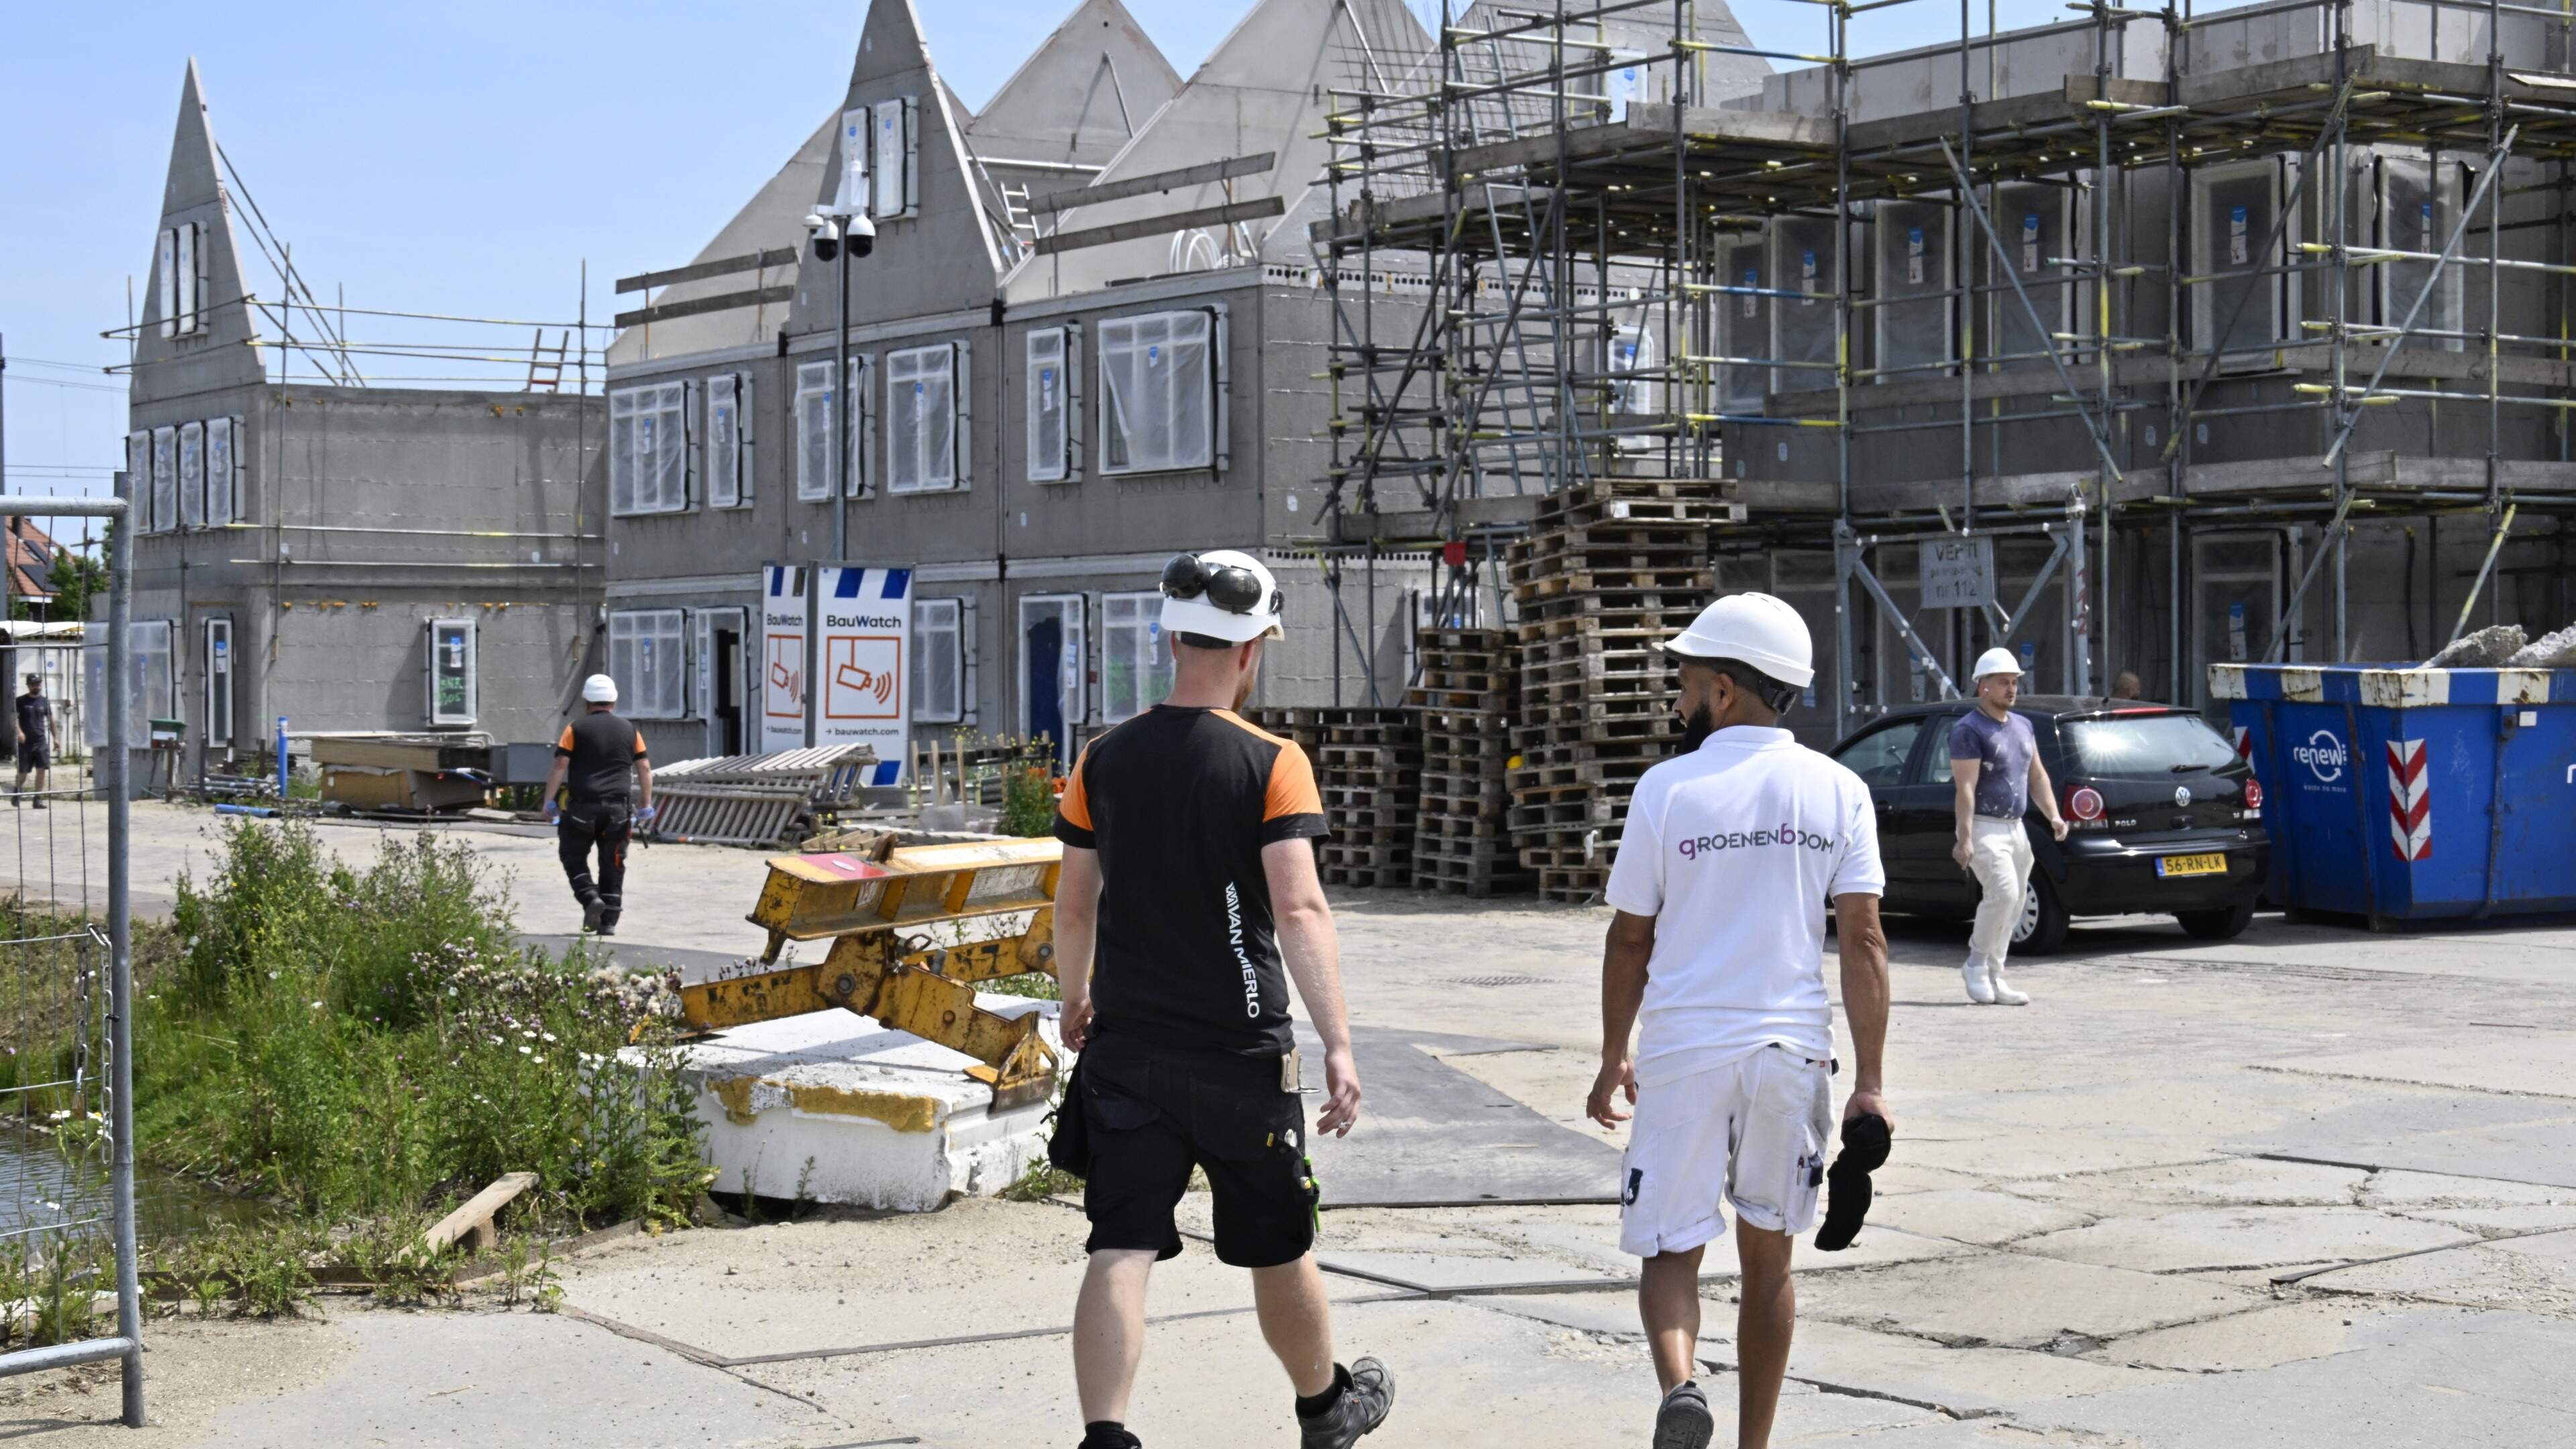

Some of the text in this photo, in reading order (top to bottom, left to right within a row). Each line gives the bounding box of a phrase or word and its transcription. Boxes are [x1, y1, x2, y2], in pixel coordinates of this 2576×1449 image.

[767, 614, 803, 626] BauWatch
[826, 615, 902, 629] BauWatch
[835, 727, 899, 736] bauwatch.com
[2114, 819, 2137, 827] POLO
[2166, 855, 2222, 872] 56-RN-LK
[1234, 947, 1259, 1018] MIERLO
